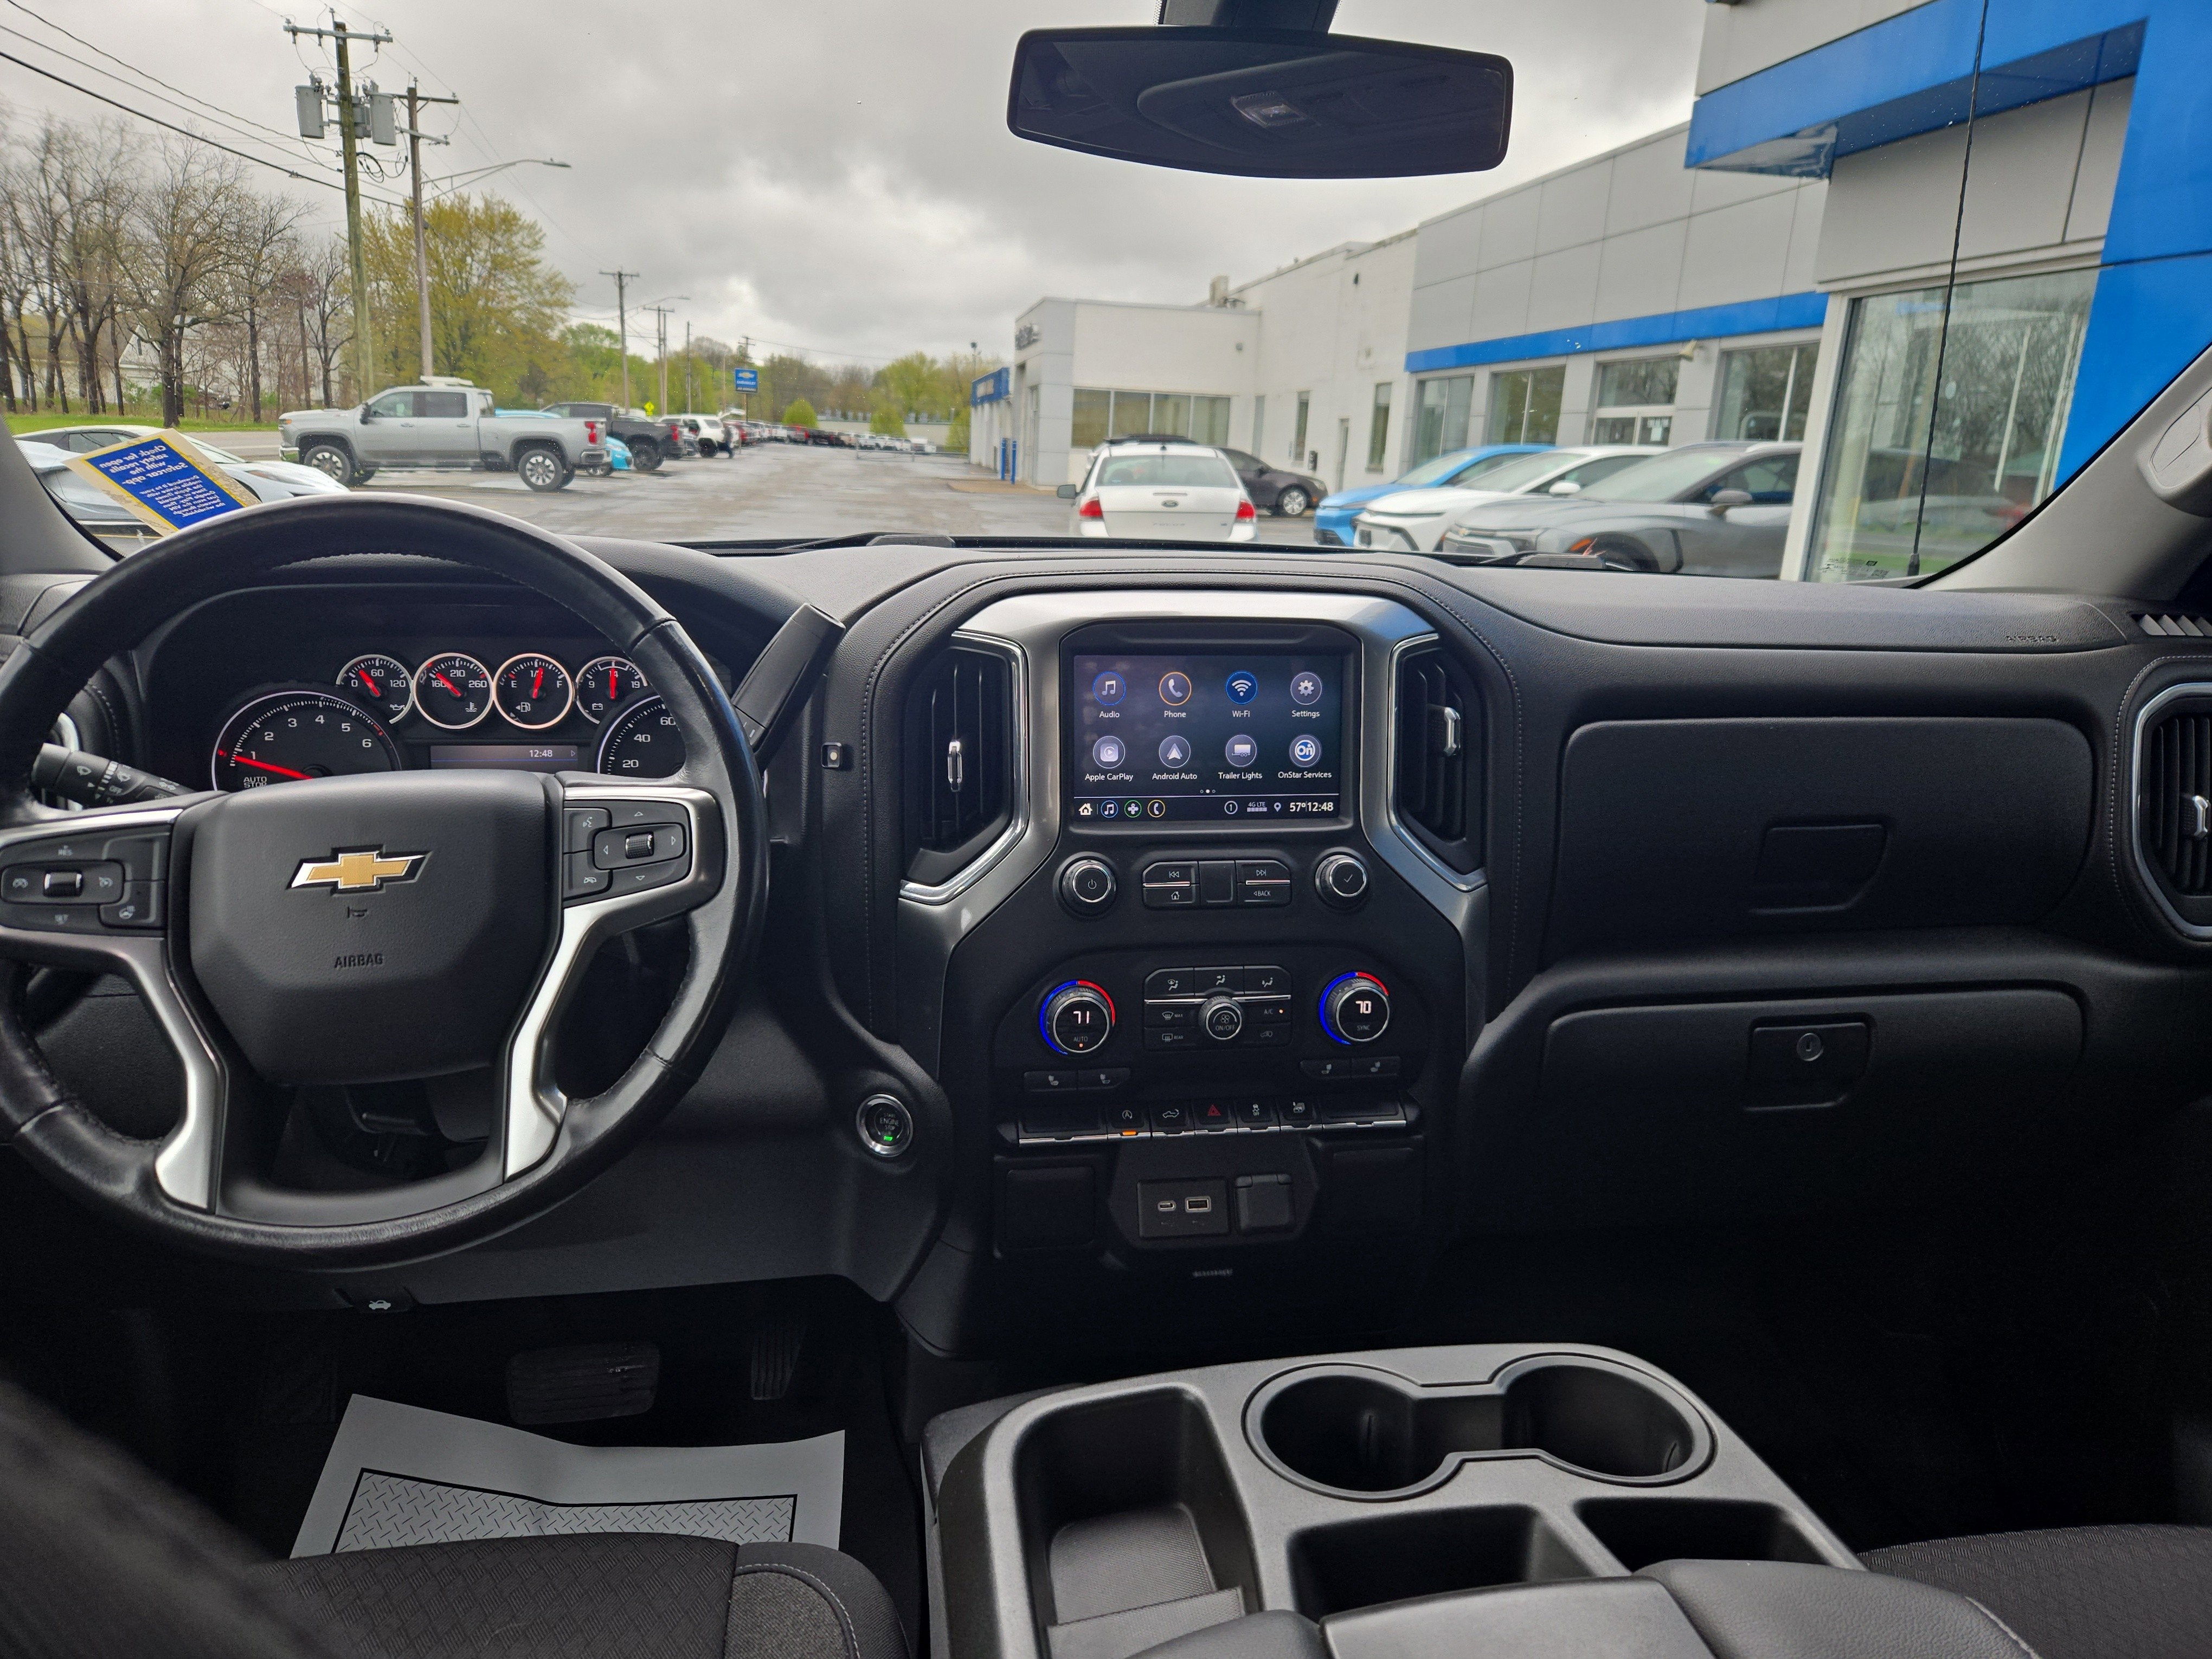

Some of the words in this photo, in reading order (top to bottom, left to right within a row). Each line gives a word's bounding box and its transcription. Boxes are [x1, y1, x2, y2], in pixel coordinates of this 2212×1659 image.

[1291, 710, 1320, 718] Settings
[288, 718, 297, 728] 3
[315, 715, 325, 724] 4
[660, 717, 676, 725] 60
[341, 723, 351, 732] 5
[265, 732, 274, 741] 2
[634, 734, 651, 742] 40
[362, 738, 371, 747] 6
[250, 751, 256, 760] 1
[622, 760, 639, 768] 20
[1085, 773, 1105, 782] Apple
[1107, 773, 1133, 782] CarPlay
[1242, 772, 1262, 781] Lights
[1307, 802, 1334, 812] 12:48
[334, 953, 383, 968] AIRBAG
[1355, 1001, 1372, 1014] 70
[1073, 1011, 1090, 1024] 71
[880, 1117, 899, 1127] ENGINE
